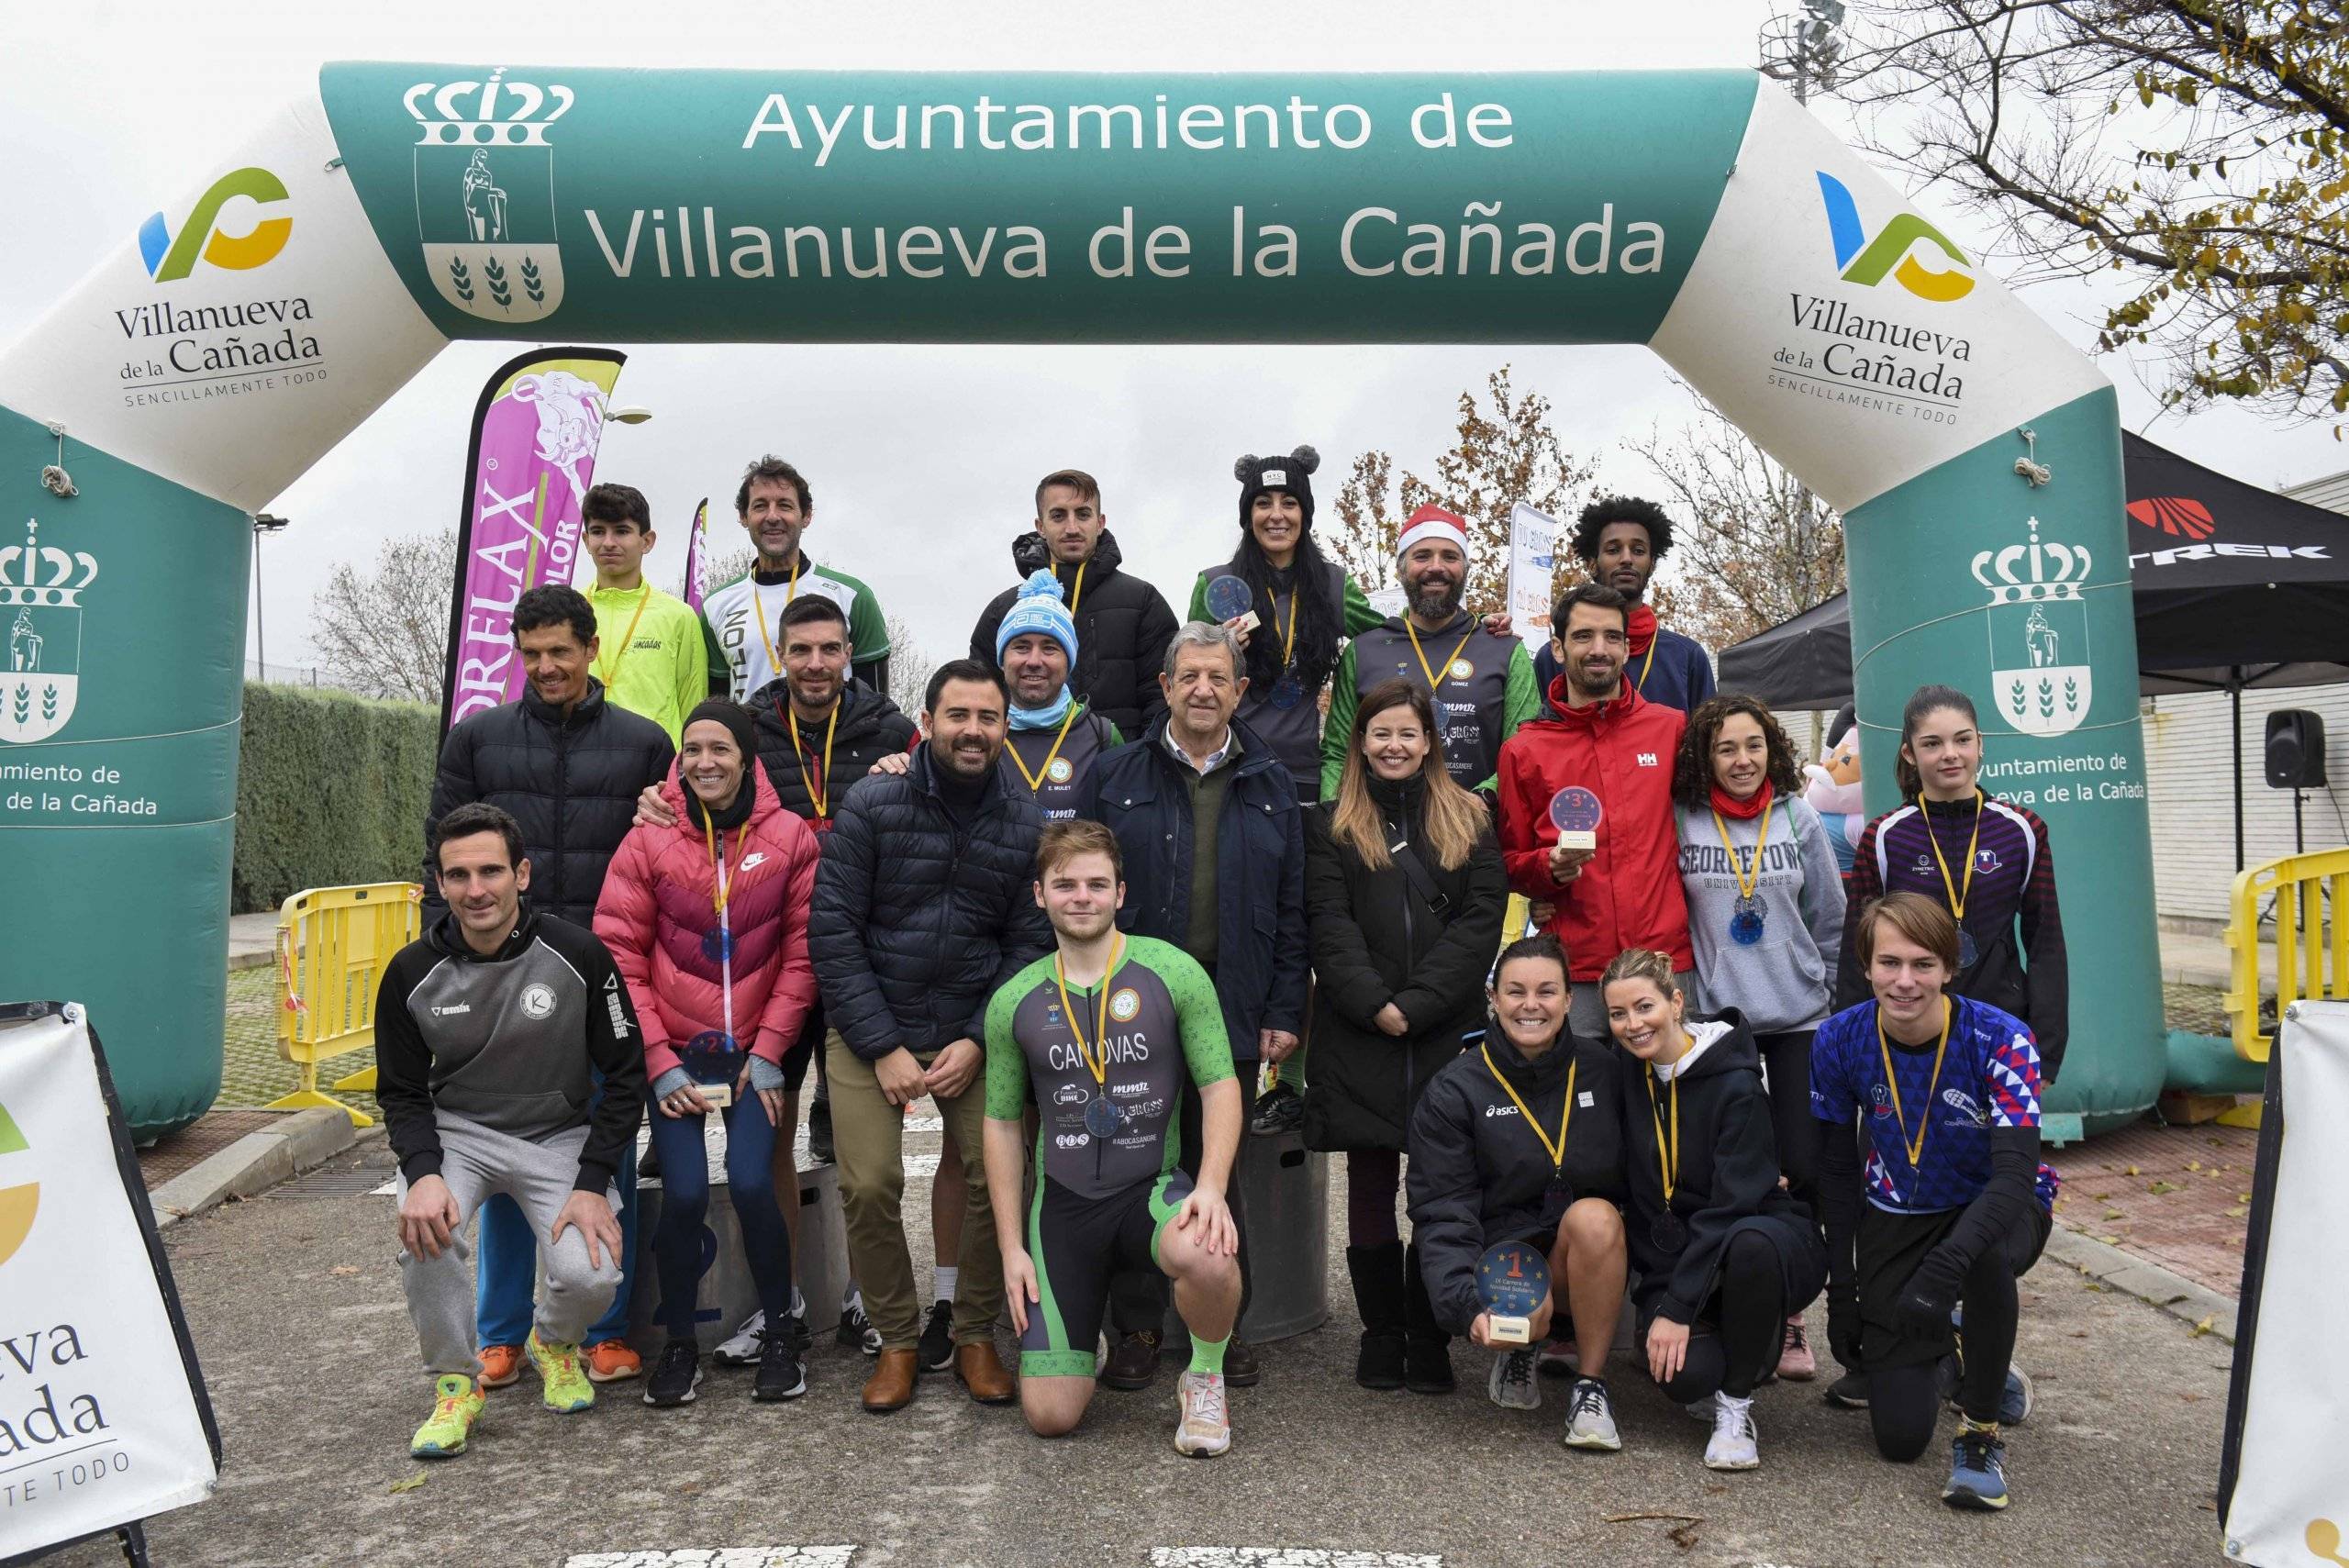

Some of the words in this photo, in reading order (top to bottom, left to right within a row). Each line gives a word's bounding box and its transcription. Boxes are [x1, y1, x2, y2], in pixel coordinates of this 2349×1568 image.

[741, 93, 1372, 167] Ayuntamiento
[1410, 93, 1514, 149] de
[584, 206, 1048, 279] Villanueva
[1088, 206, 1192, 278] de
[1232, 206, 1298, 278] la
[1340, 201, 1665, 277] Cañada
[115, 296, 314, 339] Villanueva
[1789, 293, 1972, 362] Villanueva
[120, 362, 143, 381] de
[146, 360, 164, 377] la
[169, 328, 322, 373] Cañada
[1774, 347, 1796, 365] de
[1798, 350, 1814, 370] la
[1823, 342, 1964, 400] Cañada
[125, 378, 275, 407] SENCILLAMENTE
[283, 369, 328, 387] TODO
[1767, 373, 1905, 417] SENCILLAMENTE
[1912, 406, 1957, 426] TODO
[544, 519, 578, 585] LOR
[91, 764, 121, 784] de
[1637, 752, 1656, 764] HH
[1976, 755, 2105, 783] yuntamiento
[2110, 752, 2128, 771] de
[6, 791, 33, 810] de
[41, 793, 61, 811] la
[71, 794, 158, 816] Cañada
[1571, 793, 1582, 807] 3
[1991, 790, 2036, 806] eva
[2043, 784, 2070, 804] de
[2076, 783, 2093, 801] la
[2099, 781, 2145, 800] Cañada
[744, 852, 764, 864] NIKE
[531, 993, 548, 1010] K
[707, 1036, 719, 1054] 2
[1506, 1251, 1524, 1278] 1
[4, 1478, 38, 1507] TE
[52, 1451, 129, 1492] TODO
